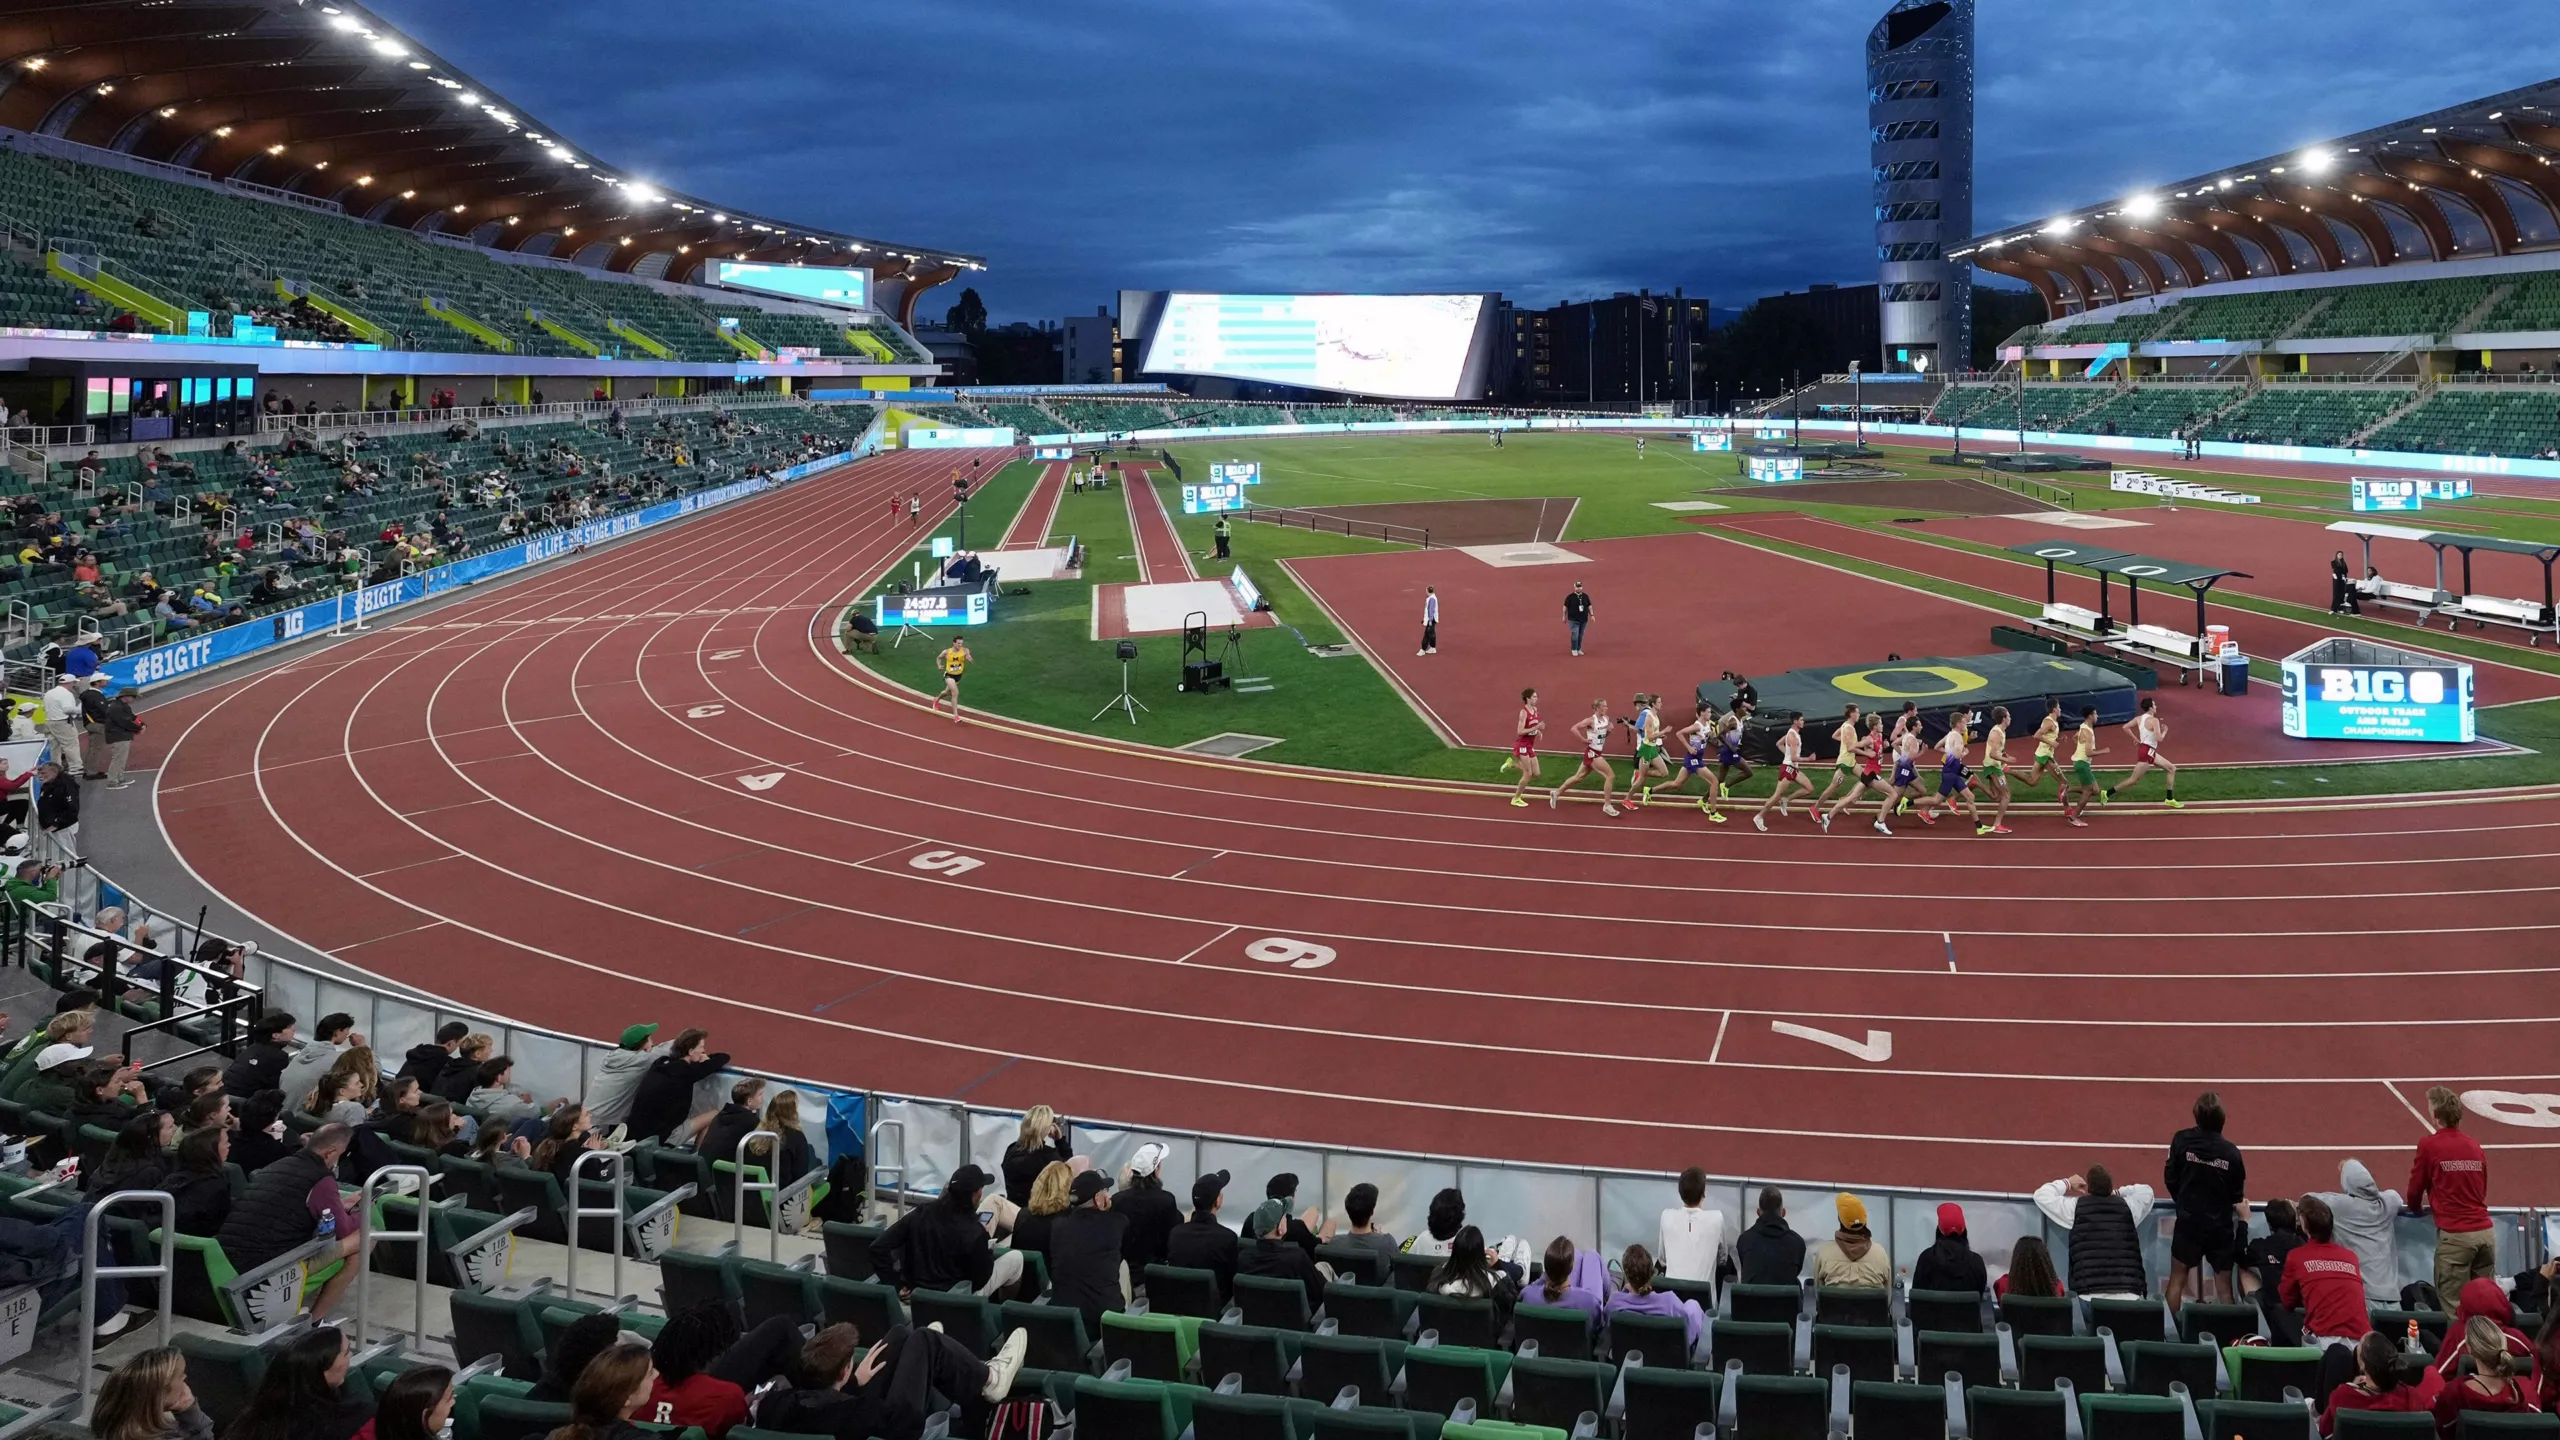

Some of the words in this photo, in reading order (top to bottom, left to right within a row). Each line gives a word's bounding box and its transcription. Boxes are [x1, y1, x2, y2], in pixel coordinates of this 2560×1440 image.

[1964, 457, 1985, 465] OREGON
[2113, 473, 2123, 484] 1ST
[2126, 478, 2139, 489] 2ND
[2142, 480, 2154, 491] 3RD
[2158, 484, 2169, 493] 4TH
[525, 540, 544, 563] BIG
[544, 534, 568, 557] LIFE.
[584, 522, 611, 544] STAGE.
[612, 520, 626, 534] BIG
[626, 513, 641, 532] TEN.
[354, 582, 403, 616] #B1GTF
[274, 610, 304, 641] B1G
[133, 637, 212, 685] #B1GTF
[2320, 669, 2405, 703] B1G
[687, 704, 725, 719] 3
[2339, 706, 2389, 716] OUTDOOR
[2392, 707, 2426, 716] TRACK
[2357, 716, 2378, 725] AND
[2381, 717, 2410, 726] FIELD
[2343, 726, 2424, 736] CHAMPIONSHIPS
[735, 772, 786, 791] 4
[908, 850, 986, 877] 5
[1244, 937, 1337, 970] 6
[1771, 1020, 1893, 1062] 7
[2459, 1089, 2560, 1128] 8
[661, 1208, 673, 1223] 118
[800, 1202, 805, 1214] A
[664, 1225, 669, 1237] B
[493, 1237, 506, 1252] 118
[495, 1252, 502, 1267] C
[280, 1268, 296, 1285] 118
[283, 1286, 291, 1303] D
[5, 1297, 27, 1317] 118
[11, 1318, 20, 1337] E
[653, 1401, 674, 1424] R
